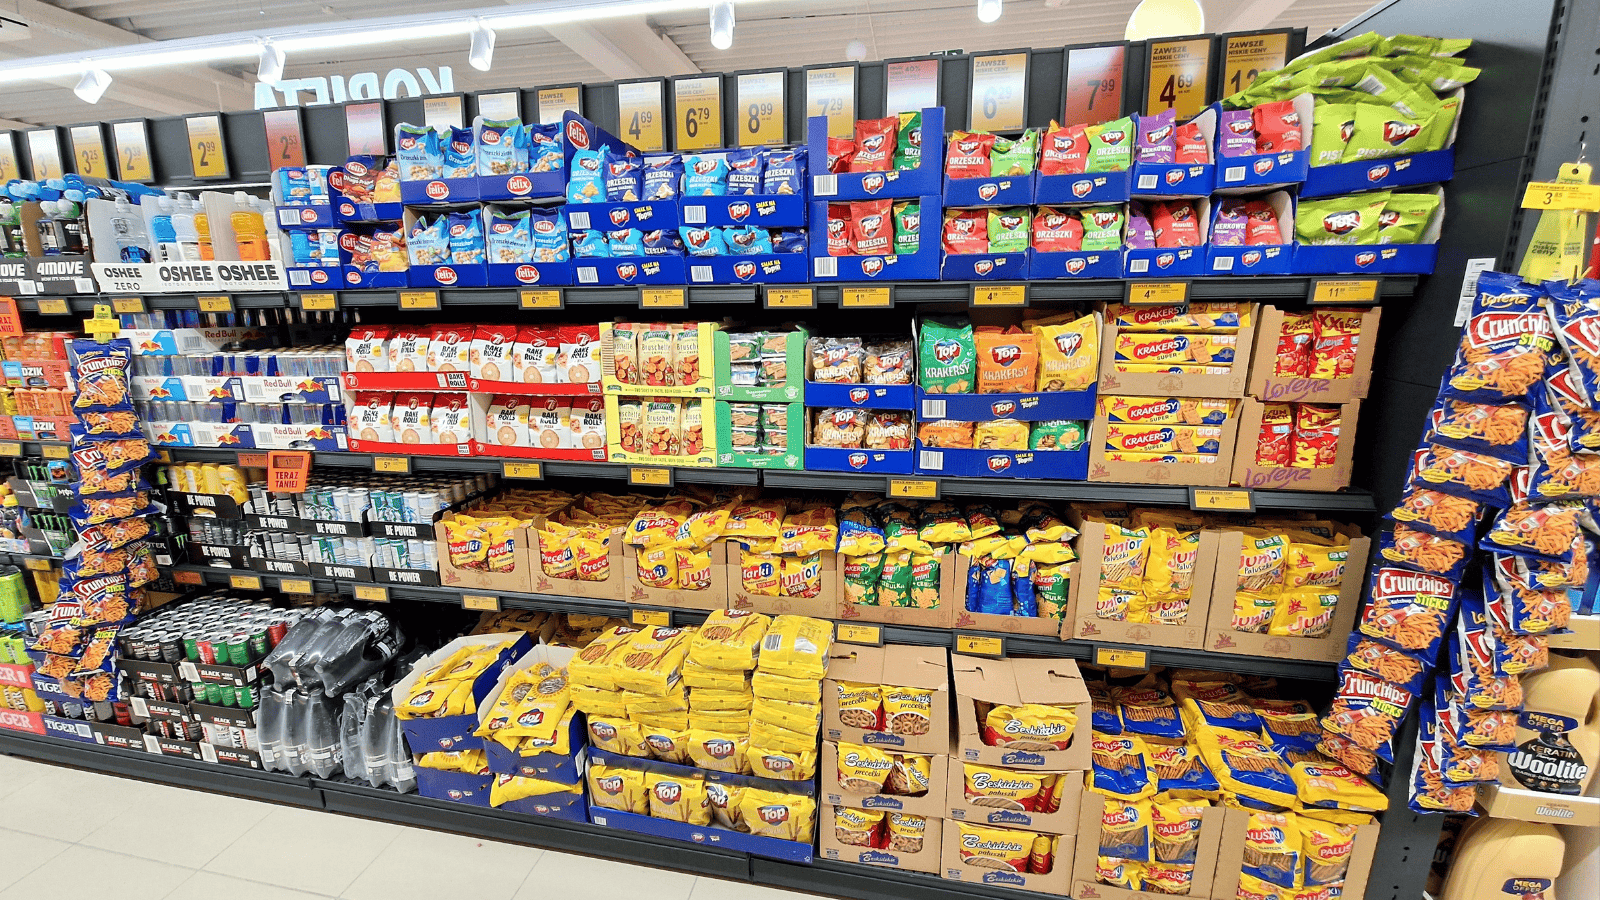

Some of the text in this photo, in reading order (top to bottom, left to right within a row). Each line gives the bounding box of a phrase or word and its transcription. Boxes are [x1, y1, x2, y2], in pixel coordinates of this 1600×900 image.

[1153, 45, 1188, 55] ZAWSZE
[1229, 40, 1264, 49] ZAWSZE
[976, 59, 1007, 68] ZAWSZE
[809, 72, 837, 81] ZAWSZE
[540, 92, 564, 100] ZAWSZE
[569, 125, 588, 145] felix
[1045, 150, 1081, 159] ORZESZKI
[428, 183, 446, 196] felix
[510, 178, 529, 192] felix
[1036, 230, 1073, 239] ORZESZKI
[857, 238, 887, 248] ORZESZKI
[37, 261, 84, 275] 4MOVE
[104, 267, 143, 278] OSHEE
[159, 266, 214, 281] OSHEE
[217, 265, 280, 281] OSHEE
[516, 266, 540, 281] felix
[435, 268, 456, 282] felix
[114, 282, 140, 290] ZERO
[1480, 293, 1528, 309] Lorenz
[1137, 304, 1186, 322] KRAKERSY
[1136, 339, 1186, 355] KRAKERSY
[1518, 333, 1554, 351] STICKS
[485, 344, 503, 353] BAKE
[1159, 353, 1179, 361] SUPER
[22, 367, 43, 376] DZIK
[925, 363, 971, 377] KRAKERSY
[982, 366, 1028, 380] KRAKERSY
[1263, 378, 1330, 399] Lorenz
[1130, 402, 1178, 418] KRAKERSY
[33, 421, 56, 431] DZIK
[287, 427, 302, 435] Bull
[1125, 431, 1172, 446] KRAKERSY
[275, 471, 299, 480] TERAZ
[1245, 467, 1312, 490] Lorenz
[275, 480, 298, 489] TANIEJ
[188, 495, 216, 507] BE POWER
[259, 518, 288, 529] BE POWER
[316, 523, 346, 535] BE POWER
[385, 525, 417, 537] BE POWER
[201, 546, 230, 558] BE POWER
[77, 575, 125, 598] Crunchips
[106, 584, 125, 593] STICKS
[1380, 573, 1453, 594] Crunchips
[1414, 592, 1449, 610] STICKS
[141, 672, 157, 680] BLACK
[201, 670, 220, 678] BLACK
[1370, 696, 1404, 718] STICKS
[213, 717, 230, 725] BLACK
[1004, 718, 1066, 735] Beskidzkie
[1527, 719, 1564, 732] OFFER
[1529, 713, 1564, 728] MEGA
[45, 720, 77, 734] TIGER
[108, 735, 127, 744] BLACK
[162, 742, 181, 751] BLACK
[1094, 740, 1132, 752] PALUSZKI
[1528, 743, 1577, 758] KERATIN
[219, 750, 237, 758] BLACK
[1508, 751, 1588, 779] Woolite
[972, 772, 1034, 790] Beskidzkie
[988, 790, 1018, 798] paluszki
[1535, 806, 1575, 819] Woolite
[1157, 820, 1200, 836] PALUSZKI
[962, 834, 1023, 851] Beskidzkie
[977, 848, 1007, 859] paluszki
[1512, 885, 1542, 893] OFFER
[1513, 879, 1542, 889] MEGA
